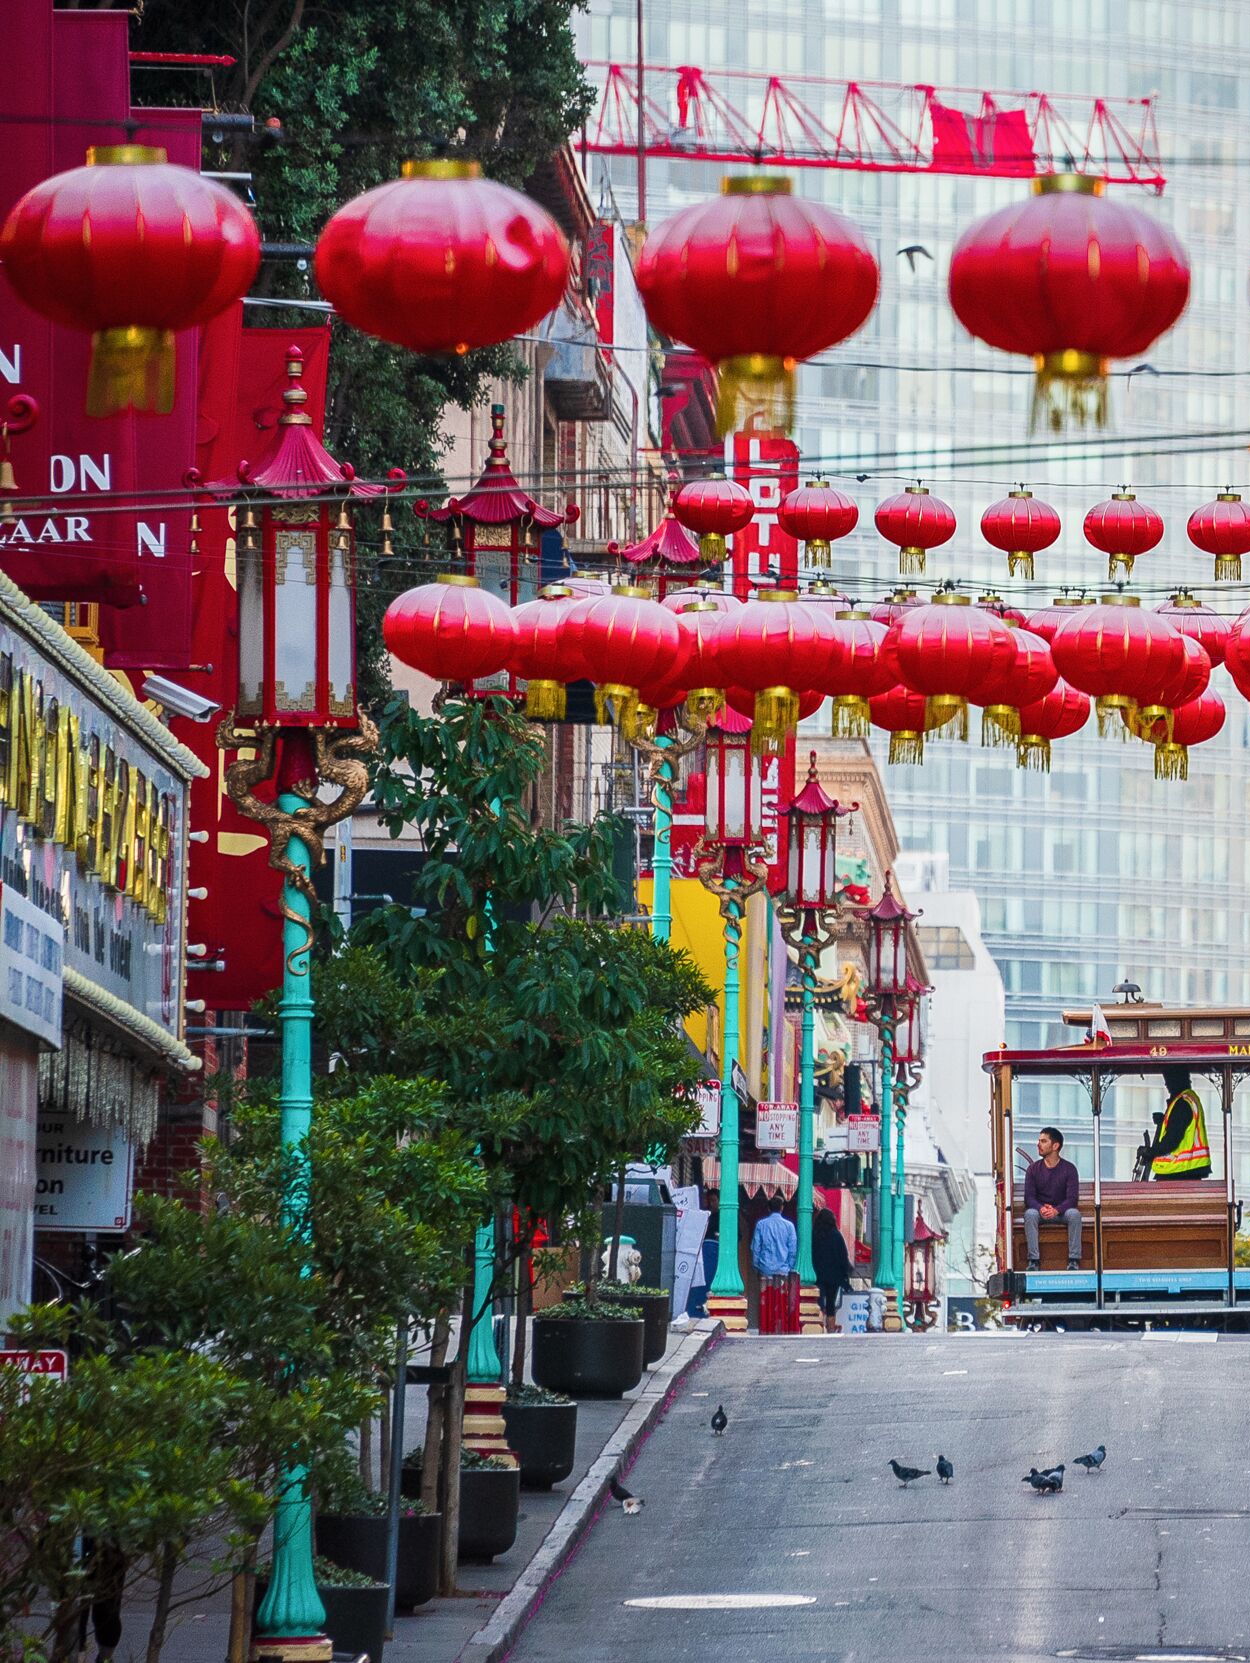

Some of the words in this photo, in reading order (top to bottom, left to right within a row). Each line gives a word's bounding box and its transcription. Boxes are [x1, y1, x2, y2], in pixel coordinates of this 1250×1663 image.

[1150, 1046, 1167, 1057] 49
[760, 1103, 795, 1111] TOW-AWAY
[40, 1123, 64, 1134] UR
[769, 1123, 784, 1132] ANY
[768, 1132, 785, 1141] TIME
